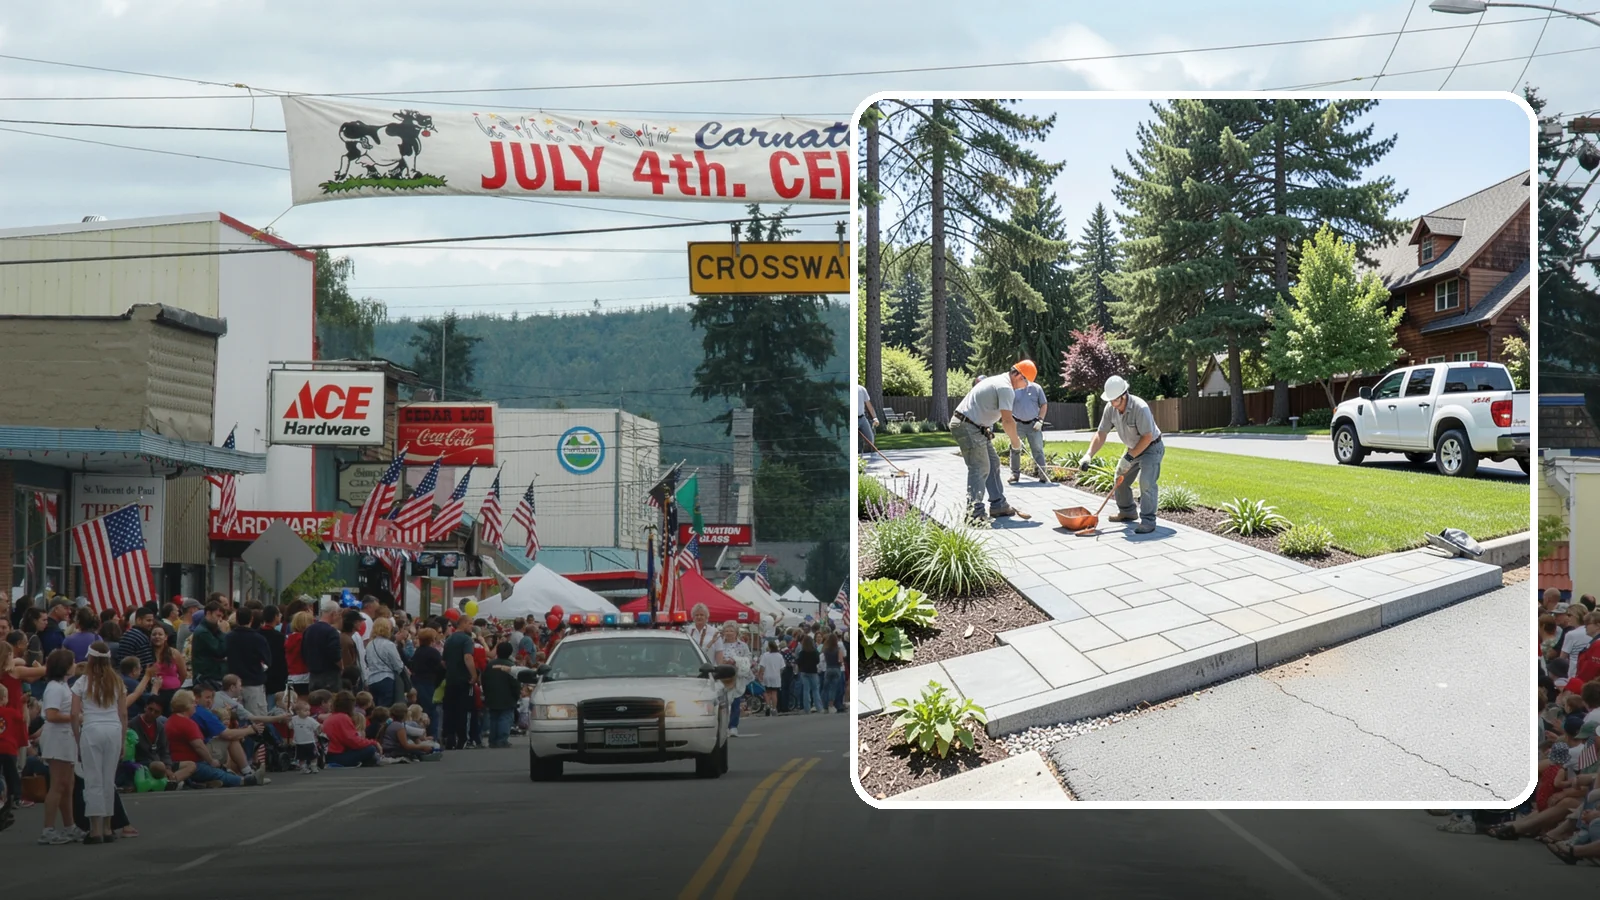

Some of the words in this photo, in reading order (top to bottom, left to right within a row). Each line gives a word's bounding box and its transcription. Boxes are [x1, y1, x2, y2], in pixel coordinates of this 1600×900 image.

[694, 121, 850, 150] Carnat
[481, 140, 605, 193] JULY
[632, 149, 747, 198] 4th.
[697, 254, 850, 280] CROSSWA
[282, 379, 374, 420] ACE
[405, 408, 452, 422] CEDAR
[460, 408, 485, 422] LOG
[283, 421, 371, 436] Hardware
[353, 467, 386, 482] Simpl
[95, 485, 124, 495] Vincent
[126, 486, 136, 495] de
[138, 486, 155, 495] Paul
[688, 526, 741, 535] CRNATION
[699, 535, 730, 543] GLASS
